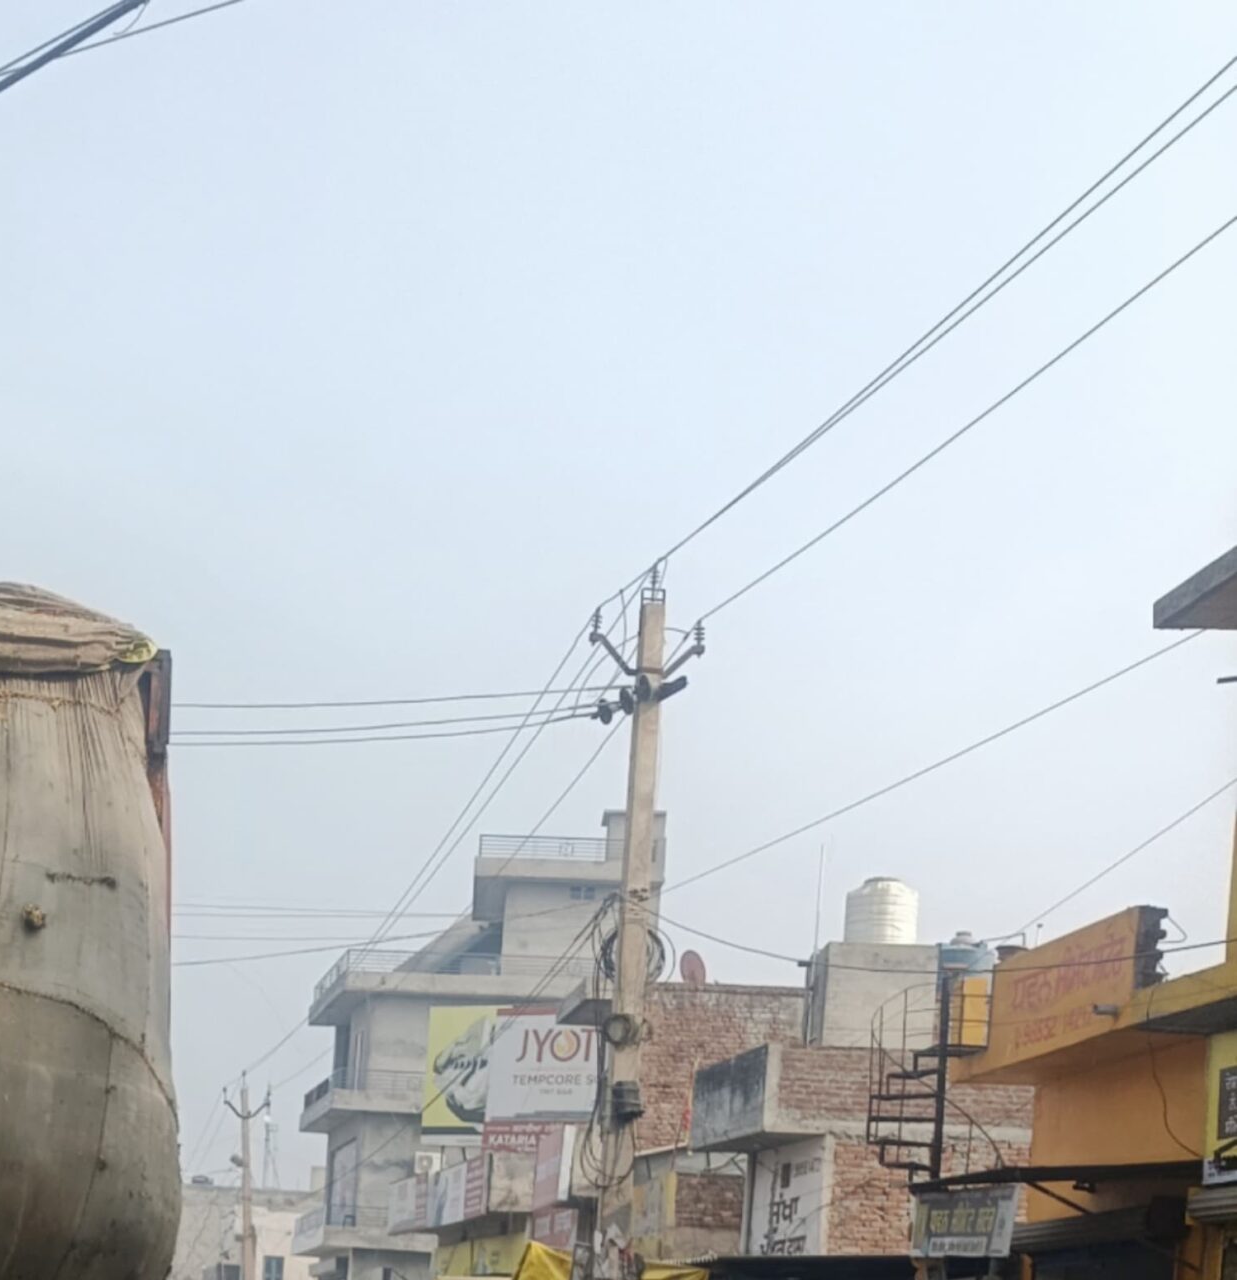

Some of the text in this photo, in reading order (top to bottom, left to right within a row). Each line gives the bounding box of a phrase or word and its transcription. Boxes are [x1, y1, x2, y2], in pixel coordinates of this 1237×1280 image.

[515, 1028, 595, 1063] JYOT
[513, 1073, 581, 1087] TEMPCORE
[489, 1133, 538, 1146] KATARIA
